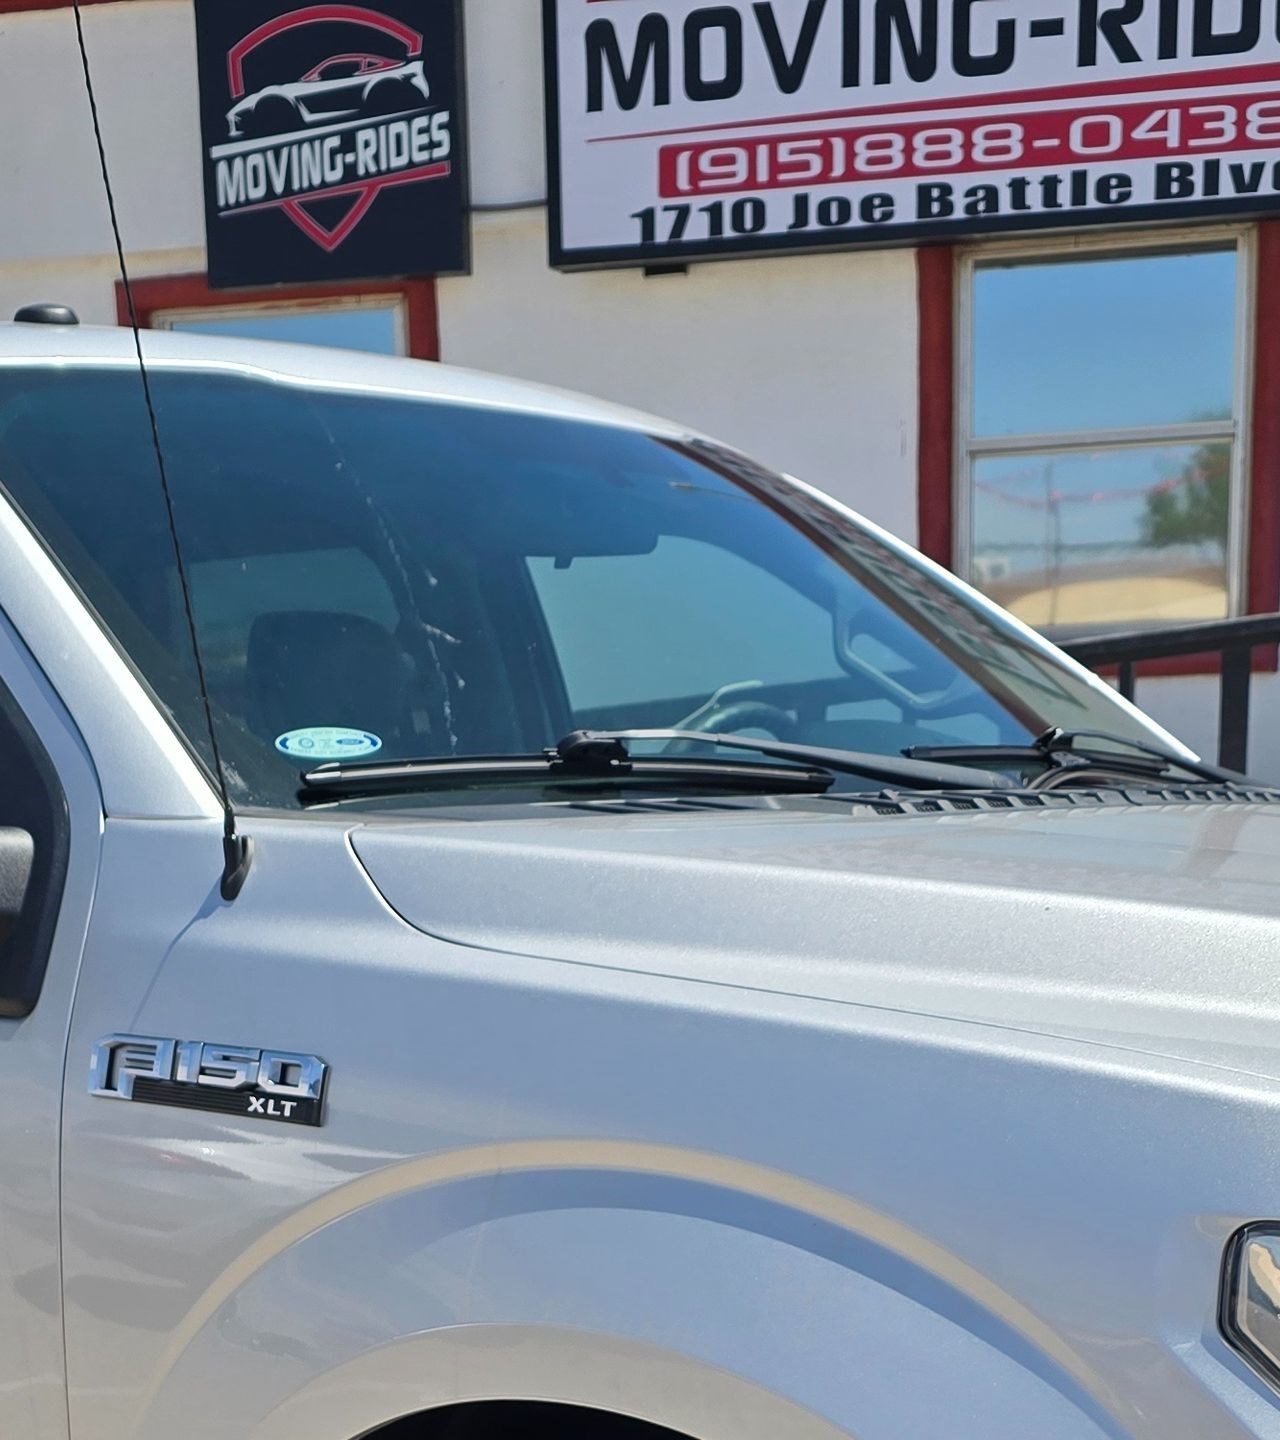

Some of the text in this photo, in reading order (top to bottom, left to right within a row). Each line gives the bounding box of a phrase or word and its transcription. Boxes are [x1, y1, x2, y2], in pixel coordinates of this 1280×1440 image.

[215, 110, 452, 207] MOVING-RIDES
[629, 196, 767, 246] 1710
[788, 192, 895, 230] Joe
[916, 169, 1133, 219] Battle
[247, 1095, 298, 1118] XLT
